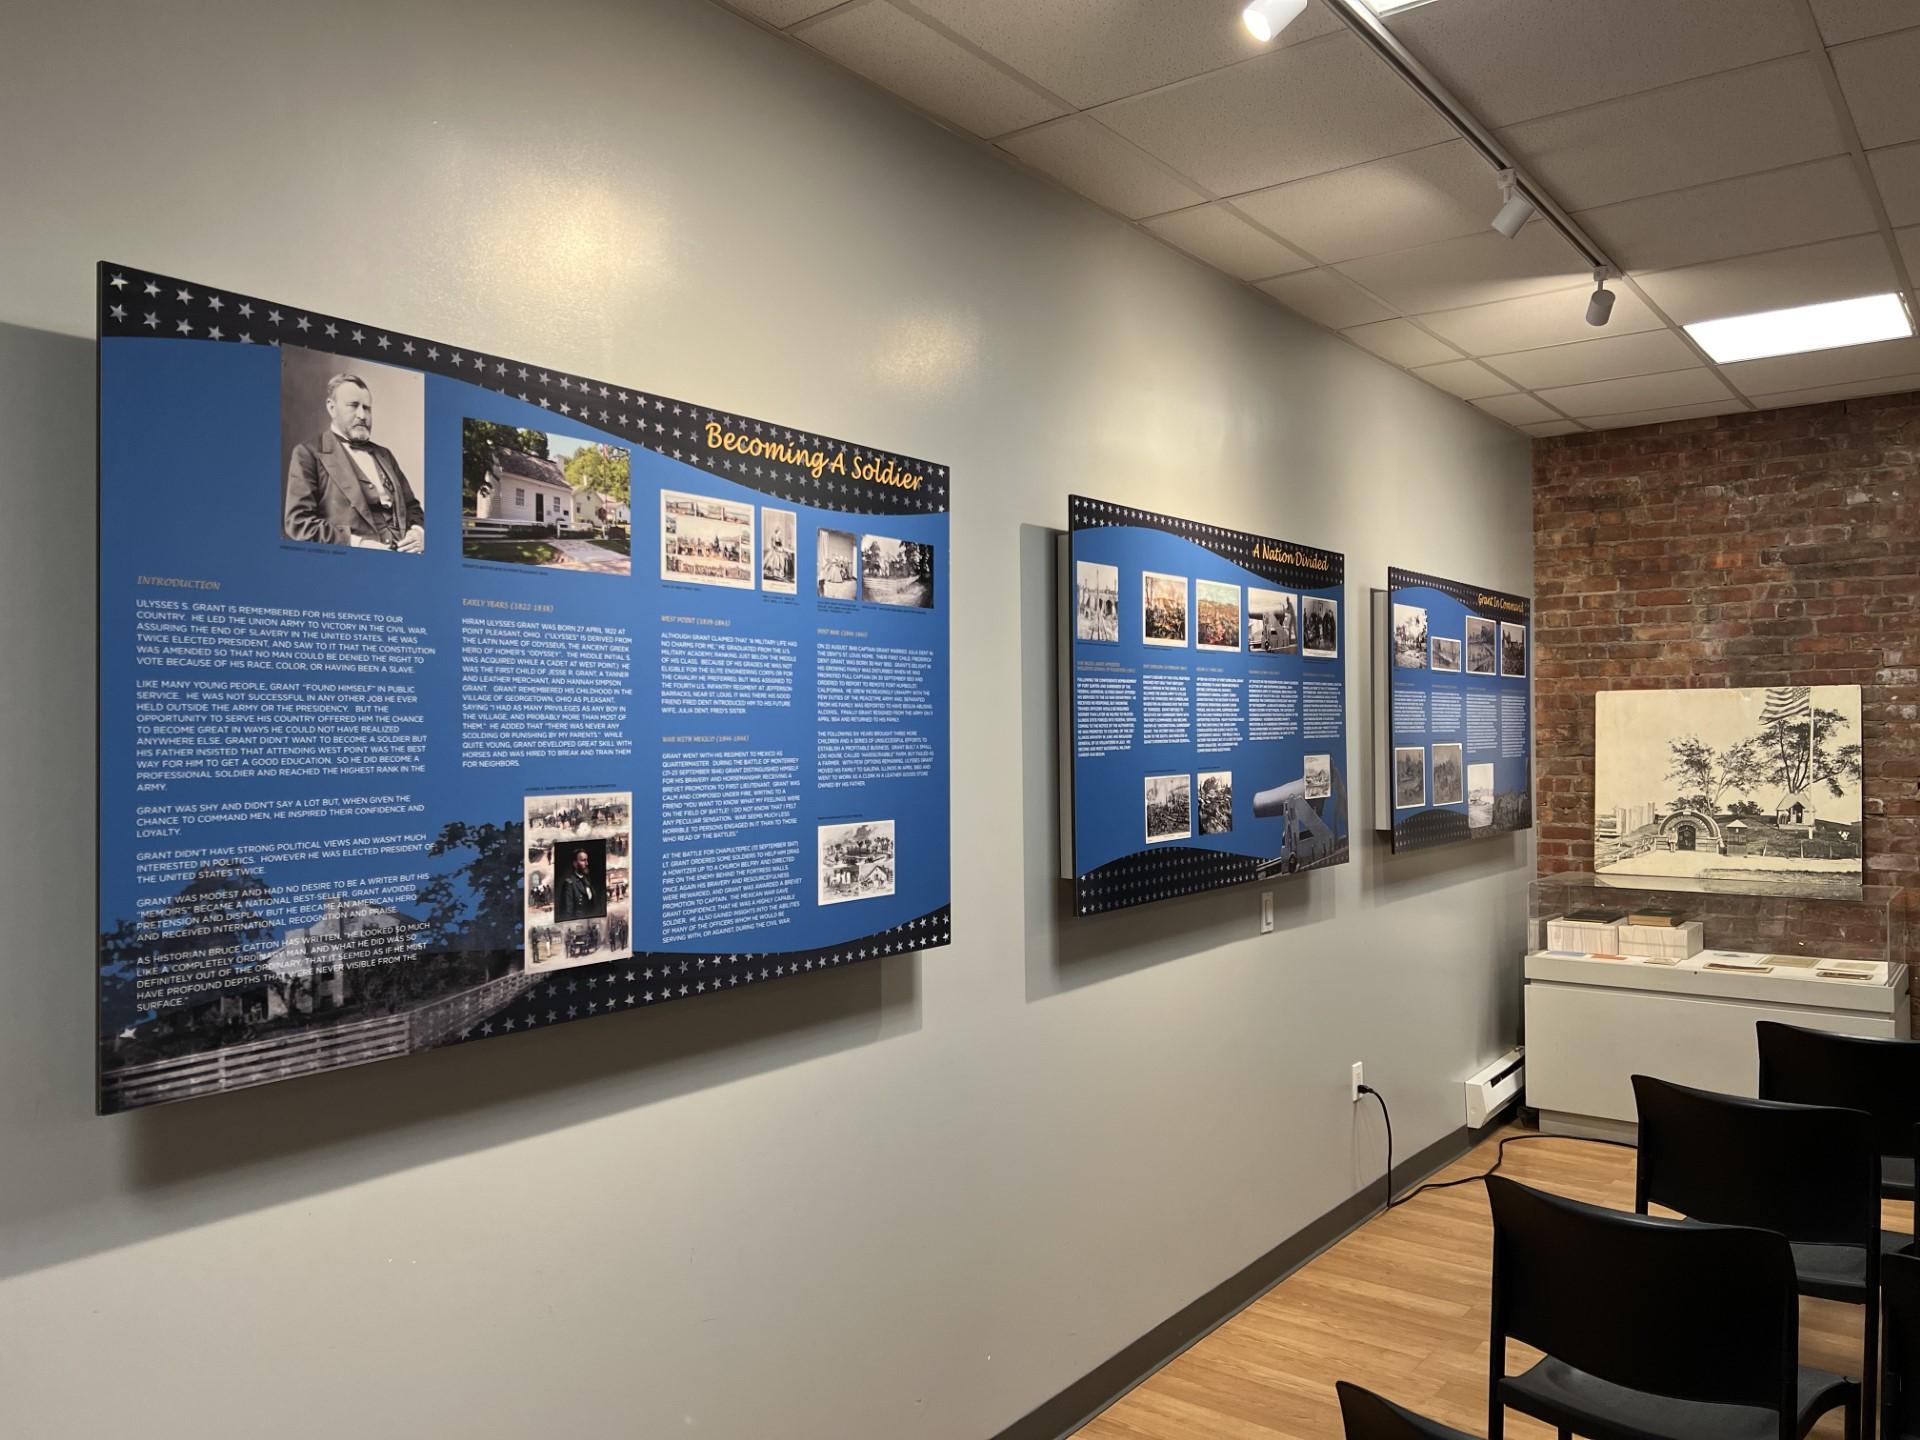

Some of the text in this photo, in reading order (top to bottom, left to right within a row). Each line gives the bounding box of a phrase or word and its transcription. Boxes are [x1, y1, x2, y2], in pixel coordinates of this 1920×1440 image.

[705, 422, 923, 491] Becoming A Soldier
[1252, 543, 1329, 571] A Nation Divided
[138, 575, 221, 591] INTRODUCTION
[136, 599, 179, 610] ULYSSES
[193, 602, 225, 613] GRANT
[229, 605, 236, 614] IS
[239, 605, 300, 618] REMEMBERED
[303, 609, 320, 619] FOR
[322, 611, 335, 620] HIS
[338, 612, 371, 622] SERVICE
[374, 614, 384, 623] TO
[386, 615, 403, 624] OUR
[137, 622, 187, 634] ASSURING
[191, 625, 208, 635] THE
[211, 626, 231, 636] END
[234, 627, 245, 636] OF
[249, 628, 288, 638] SLAVERY
[291, 630, 300, 639] IN
[303, 631, 318, 640] THE
[321, 631, 351, 641] UNITED
[388, 635, 398, 643] HE
[400, 636, 417, 644] WAS
[192, 613, 204, 623] HE
[207, 614, 225, 624] LED
[229, 615, 246, 625] THE
[249, 617, 278, 627] UNION
[281, 619, 304, 629] ARMY
[309, 620, 319, 629] TO
[322, 621, 356, 631] VICTORY
[359, 623, 367, 632] IN
[370, 624, 384, 633] THE
[387, 625, 405, 634] CIVIL
[137, 645, 424, 664] WAS AMENDED SO THAT NO MAN COULD BE DENIED THE RIGHT TO
[138, 633, 169, 644] TWICE
[172, 635, 215, 646] ELECTED
[273, 640, 291, 649] AND
[294, 641, 313, 650] SAW
[316, 642, 327, 651] TO
[329, 642, 336, 651] IT
[339, 643, 359, 652] THAT
[362, 644, 376, 653] THE
[379, 645, 435, 655] CONSTITUTION
[137, 656, 163, 666] VOTE
[166, 657, 211, 668] BECAUSE
[214, 659, 226, 668] OF
[230, 659, 245, 669] HIS
[310, 663, 322, 671] OR
[325, 663, 356, 672] HAVING
[358, 664, 379, 673] BEEN
[381, 665, 387, 673] A
[136, 714, 424, 723] OPPORTUNITY TO SERVE HIS COUNTRY OFFERED HIM THE CHANCE
[137, 805, 171, 816] GRANT
[175, 804, 197, 814] WAS
[200, 803, 218, 813] SHY
[222, 802, 242, 812] AND
[244, 800, 273, 810] DIDN'T
[277, 800, 293, 809] SAY
[296, 799, 301, 808] A
[304, 798, 319, 808] LOT
[343, 796, 367, 806] WHEN
[370, 795, 394, 804] GIVEN
[396, 795, 410, 803] THE
[137, 816, 178, 827] CHANCE
[183, 815, 195, 825] TO
[198, 812, 247, 824] COMMAND
[274, 811, 285, 820] HE
[288, 809, 327, 819] INSPIRED
[331, 807, 352, 817] THEIR
[355, 805, 405, 815] CONFIDENCE
[408, 804, 424, 813] AND
